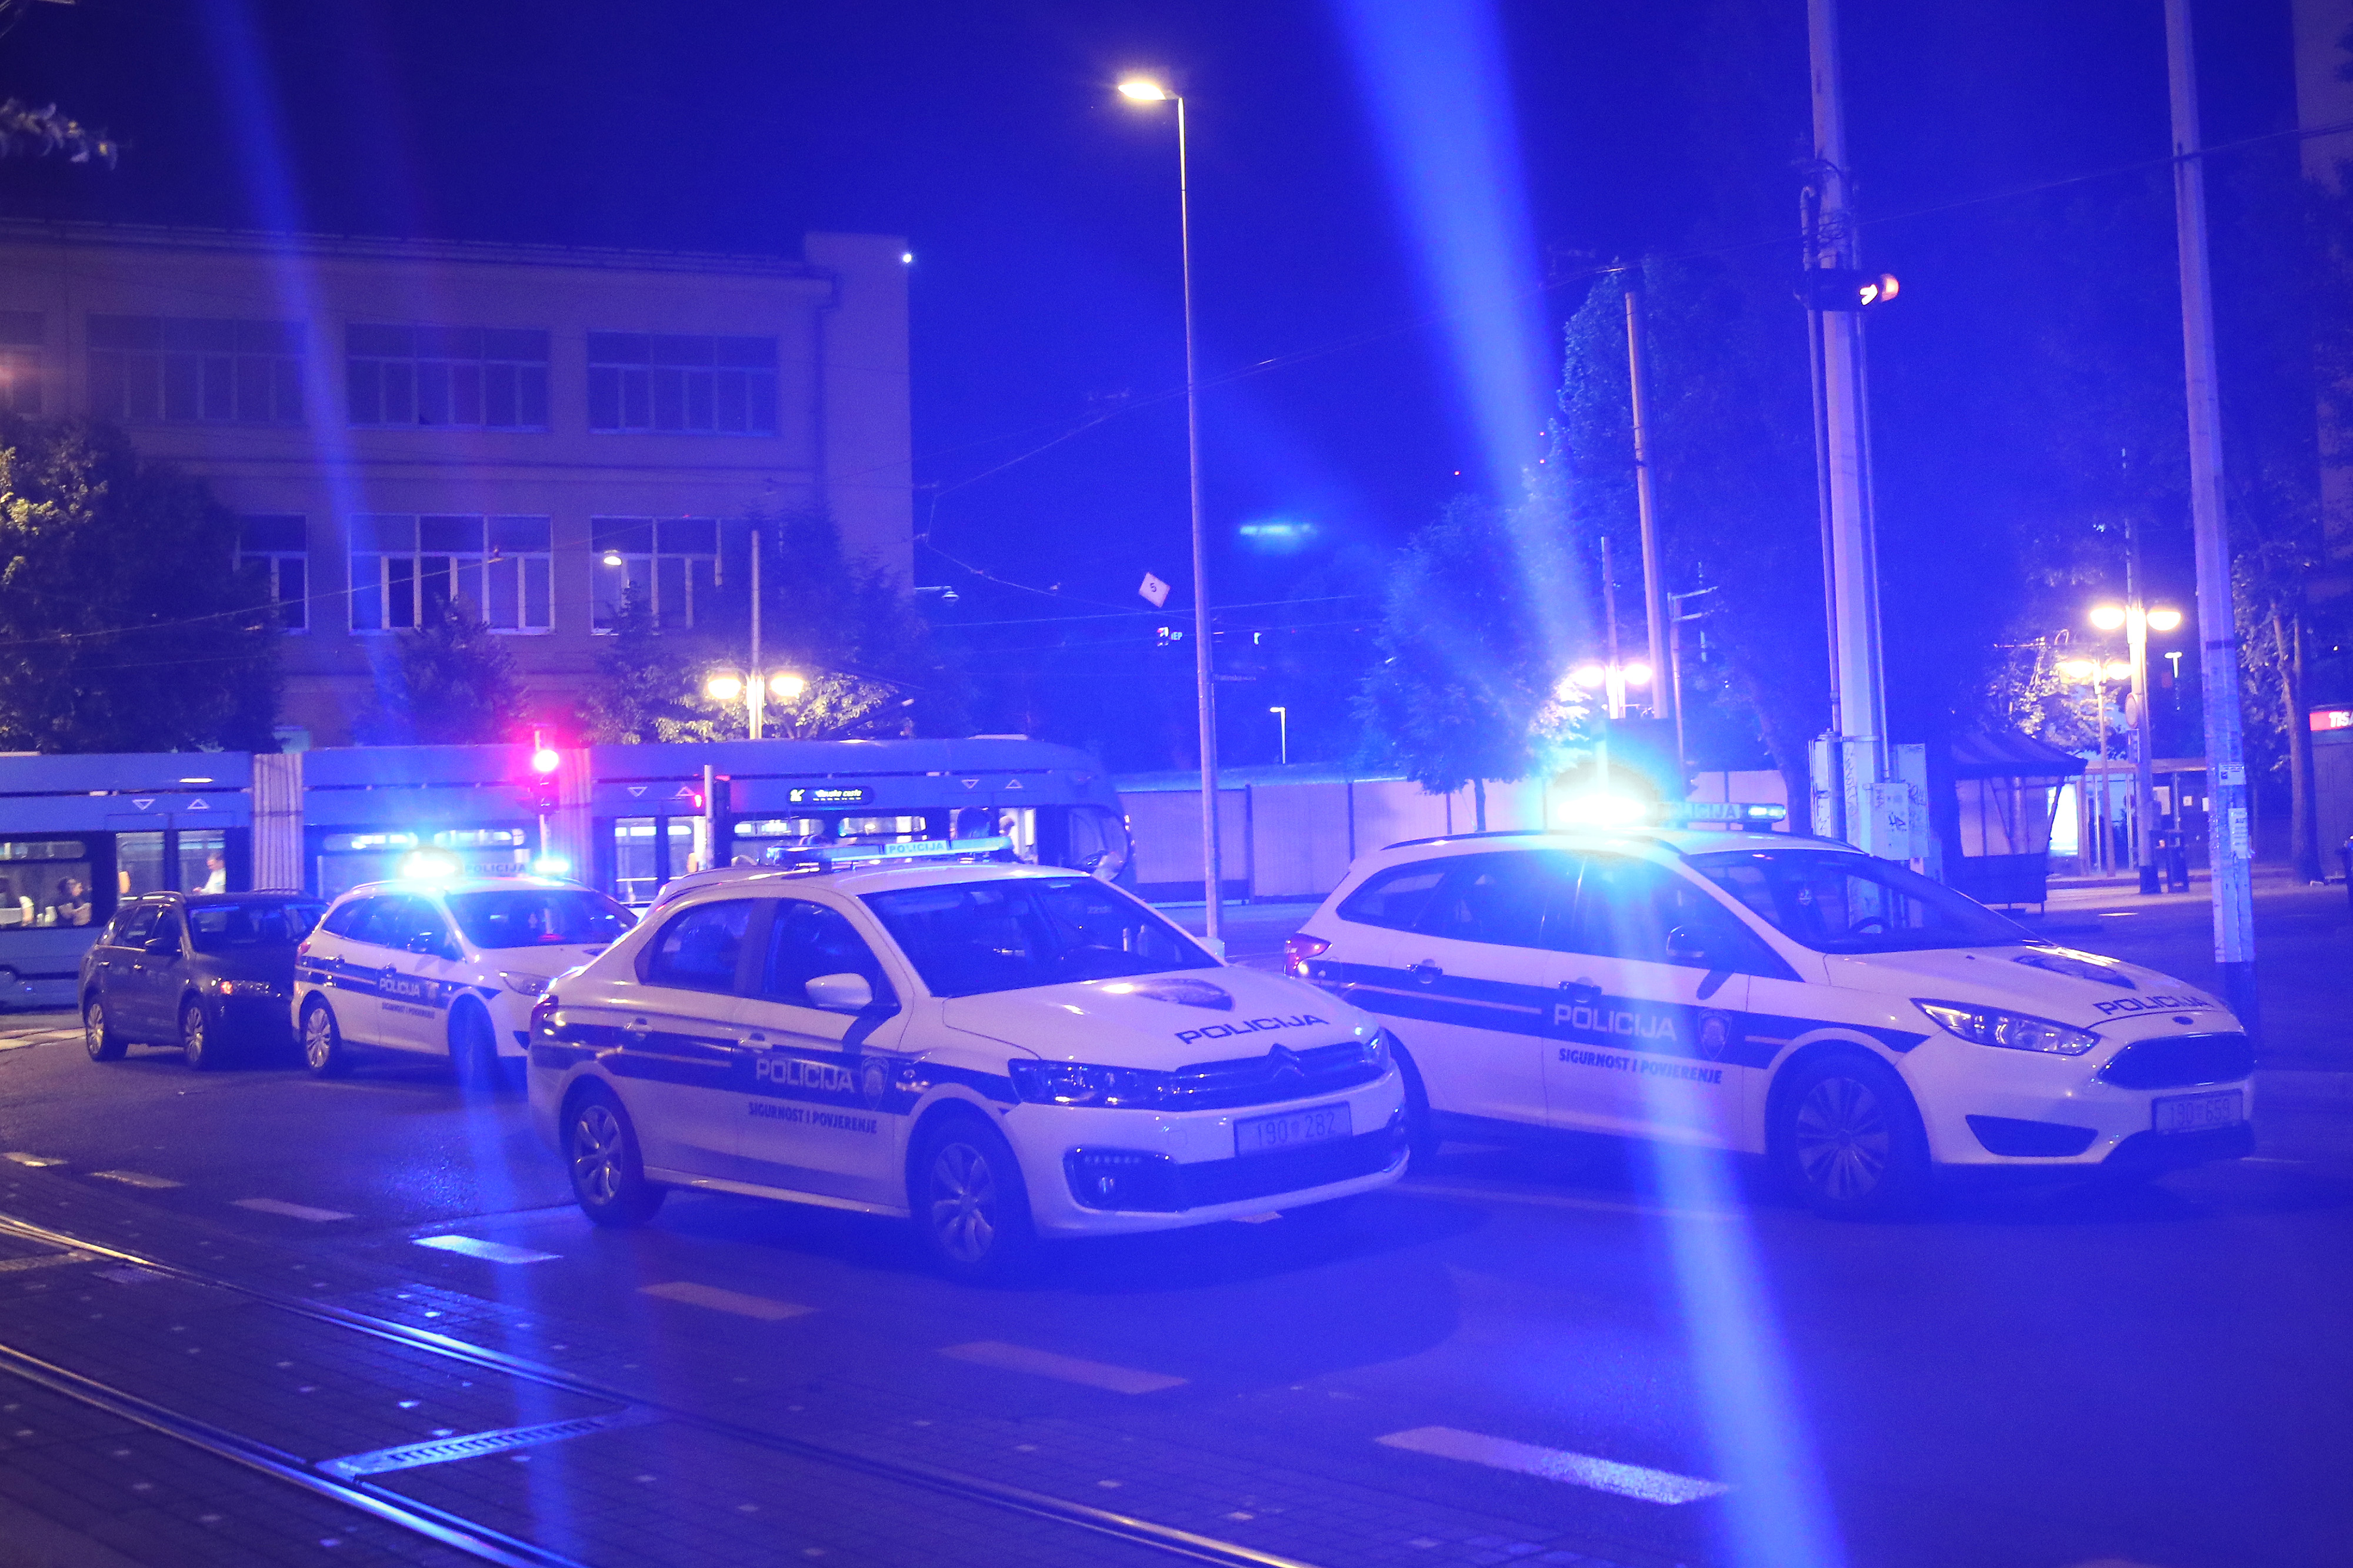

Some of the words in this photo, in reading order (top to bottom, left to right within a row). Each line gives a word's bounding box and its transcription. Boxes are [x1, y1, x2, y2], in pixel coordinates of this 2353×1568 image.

[1149, 582, 1157, 593] 5
[889, 842, 944, 853] POLICIJA
[379, 978, 421, 998] POLICIJA
[2092, 996, 2215, 1015] POLICIJA
[1174, 1014, 1331, 1045] POLICIJA
[1554, 1003, 1677, 1041] POLICIJA
[756, 1058, 854, 1093] POLICIJA
[1559, 1047, 1629, 1071] SIGURNOST
[1632, 1059, 1638, 1072] I
[1640, 1061, 1723, 1084] POVJERENJE
[748, 1102, 804, 1122] SIGURNOST
[806, 1110, 810, 1124] I
[812, 1111, 878, 1134] POVJERENJE
[1257, 1119, 1288, 1147] 190
[1305, 1110, 1336, 1138] 282
